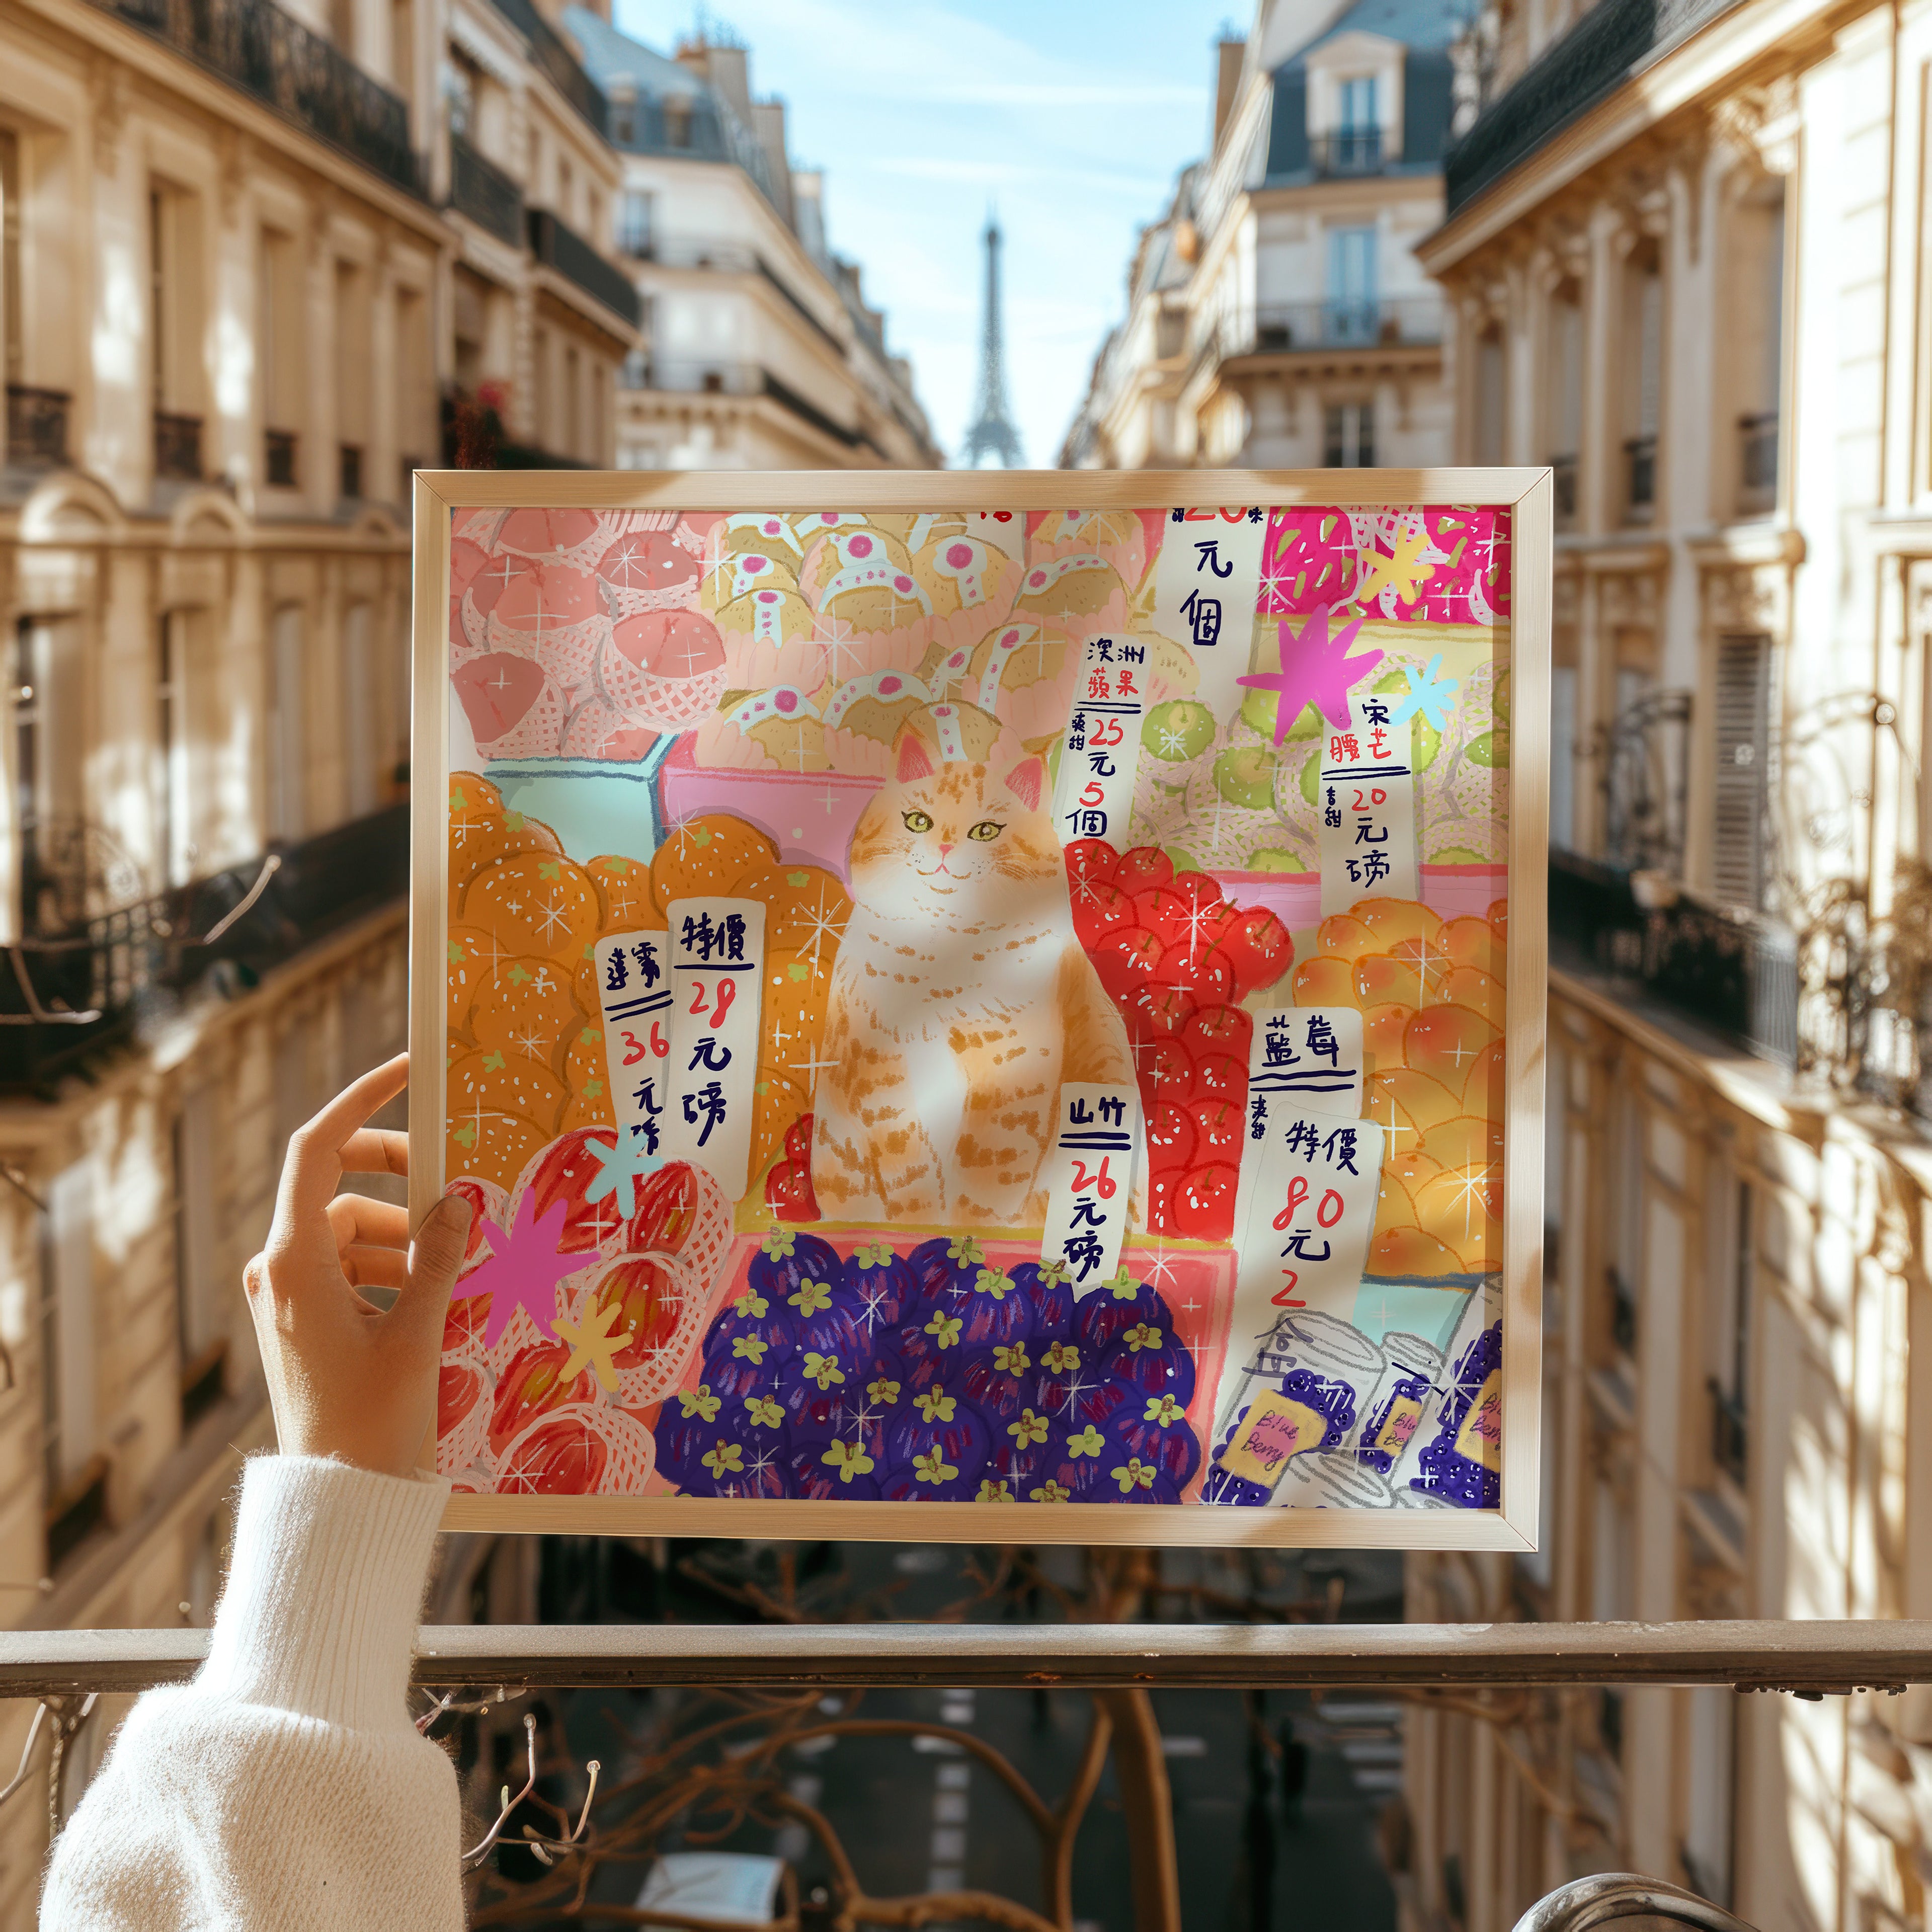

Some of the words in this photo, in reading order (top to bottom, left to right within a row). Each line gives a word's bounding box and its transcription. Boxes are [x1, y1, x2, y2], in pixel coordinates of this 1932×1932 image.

[1193, 540, 1234, 579] 元
[1179, 588, 1222, 647] 個
[1087, 637, 1145, 665] 澳洲
[1088, 717, 1124, 747] 25
[1087, 751, 1116, 777] 元
[1079, 781, 1105, 808] 5
[1351, 788, 1387, 812] 20
[1064, 808, 1108, 838] 個
[1354, 817, 1389, 845] 元
[1344, 849, 1390, 889] 磅
[679, 911, 747, 962] 特價
[688, 977, 737, 1029] 28
[620, 1020, 671, 1067] 36
[687, 1036, 733, 1072] 元
[632, 1076, 664, 1115] 元
[681, 1081, 727, 1148] 磅
[1069, 1096, 1127, 1128] 山竹
[1284, 1119, 1359, 1176] 特價
[1070, 1155, 1117, 1200] 26
[1069, 1196, 1107, 1230] 元
[1272, 1175, 1345, 1231] 80
[1063, 1230, 1104, 1283] 磅
[1280, 1229, 1331, 1262] 元
